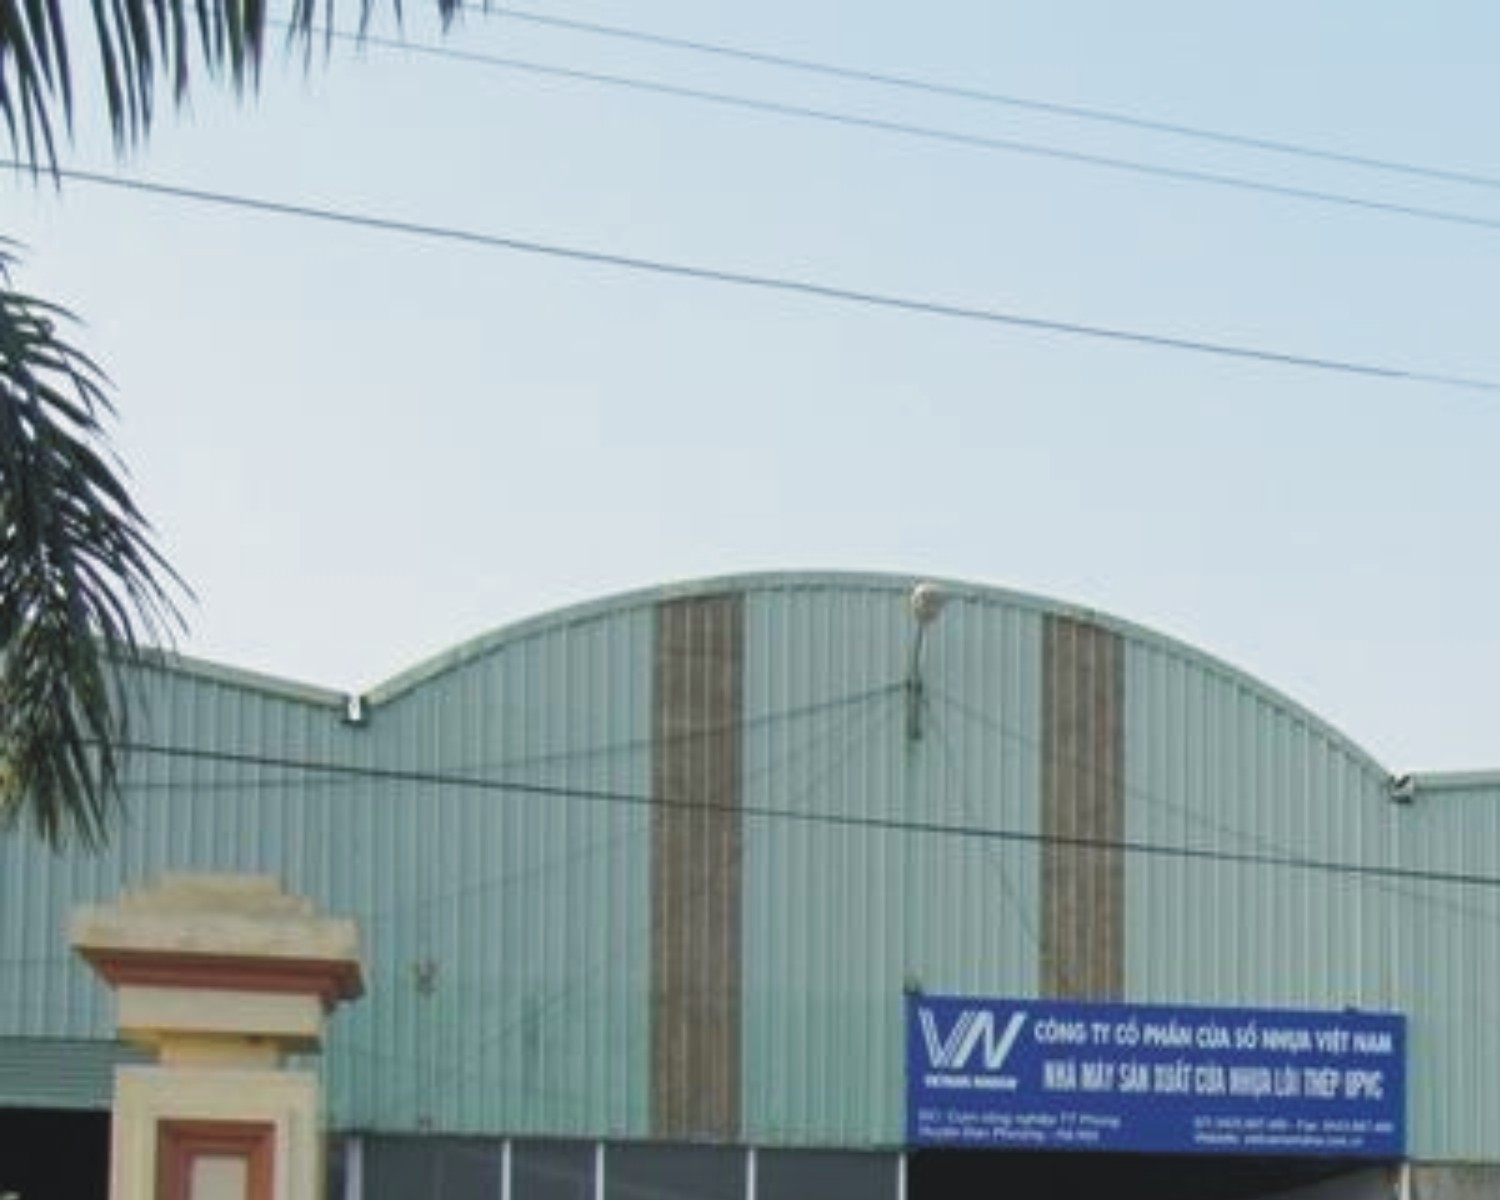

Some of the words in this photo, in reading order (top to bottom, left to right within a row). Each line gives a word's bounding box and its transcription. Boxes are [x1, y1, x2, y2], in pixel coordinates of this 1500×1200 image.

[1034, 1016, 1087, 1045] CÔNG
[1090, 1021, 1112, 1044] TY
[1352, 1030, 1394, 1054] NAM
